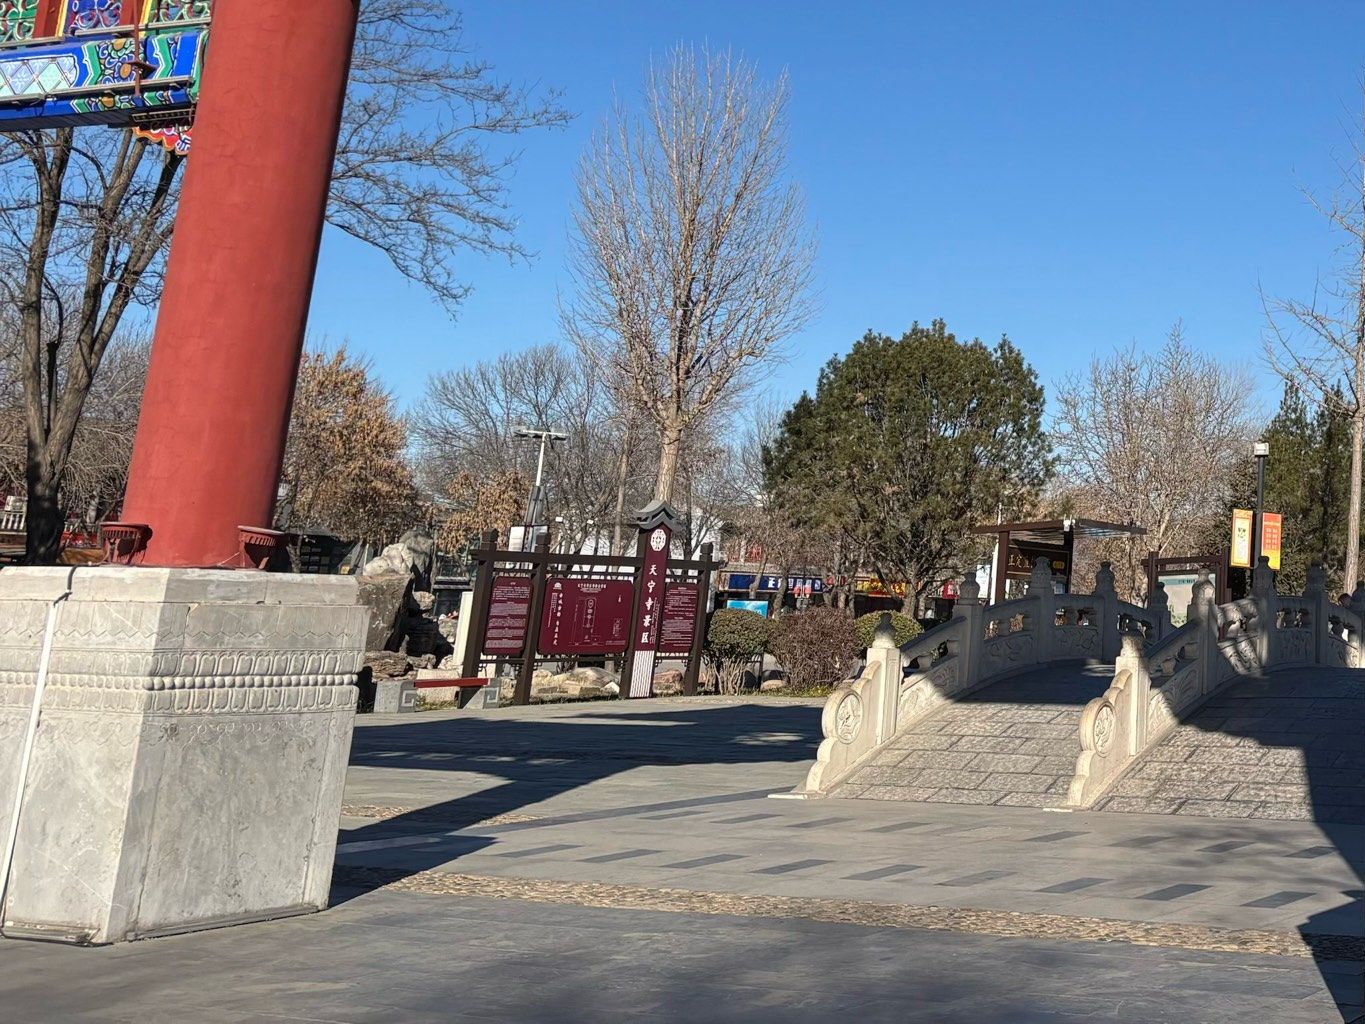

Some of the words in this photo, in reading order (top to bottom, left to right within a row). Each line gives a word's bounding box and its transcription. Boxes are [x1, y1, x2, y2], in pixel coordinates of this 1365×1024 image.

[641, 564, 657, 644] 天宁寺景区
